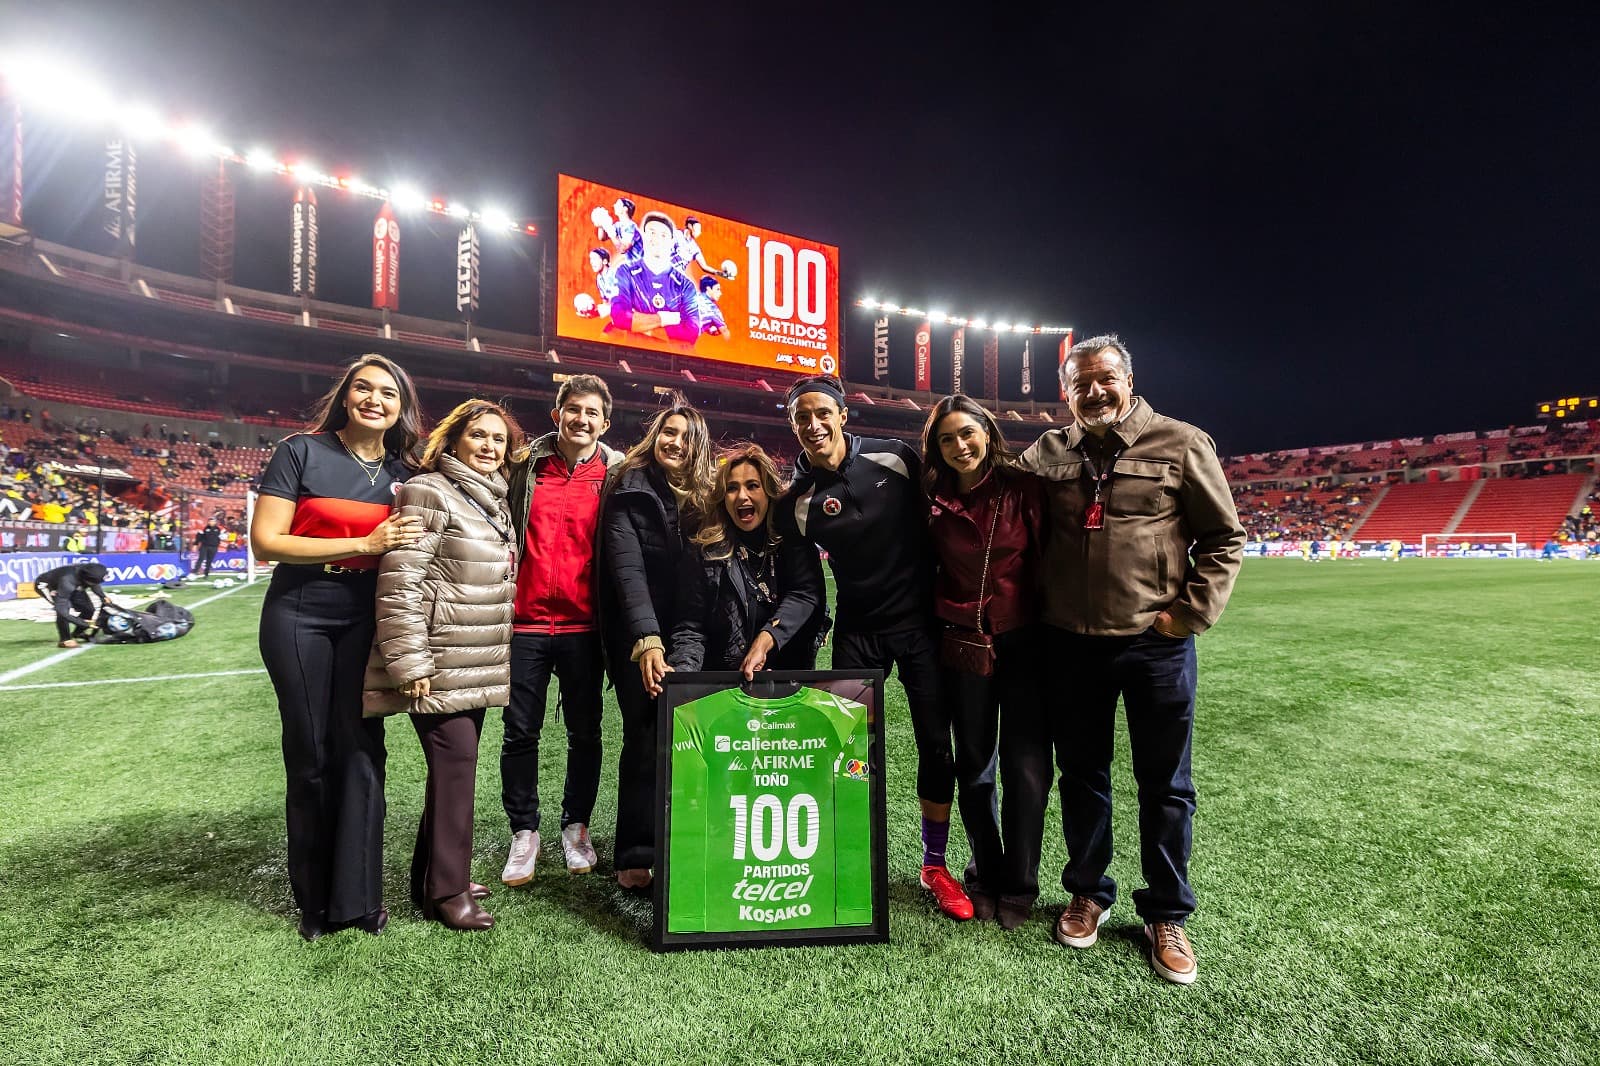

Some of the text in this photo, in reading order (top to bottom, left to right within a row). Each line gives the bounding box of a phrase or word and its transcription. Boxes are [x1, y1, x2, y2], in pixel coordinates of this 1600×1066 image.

[375, 240, 385, 292] Calimax
[389, 242, 399, 295] Calimax
[457, 223, 470, 312] TECATE
[745, 235, 827, 326] 100
[748, 315, 827, 341] PARTIDOS
[749, 330, 828, 351] XOLOITZCUINTLES
[874, 316, 888, 380] TECATE
[918, 346, 926, 381] Calimax
[954, 338, 963, 393] caliente.mx
[103, 565, 147, 582] BVA
[761, 721, 796, 730] Calimax
[732, 737, 827, 751] caliente.mx
[750, 755, 815, 770] AFIRME
[754, 771, 789, 787] TOÑO
[729, 793, 820, 862] 100
[743, 863, 810, 879] PARTIDOS
[732, 874, 815, 902] telcel
[739, 903, 812, 924] KOSAKO
